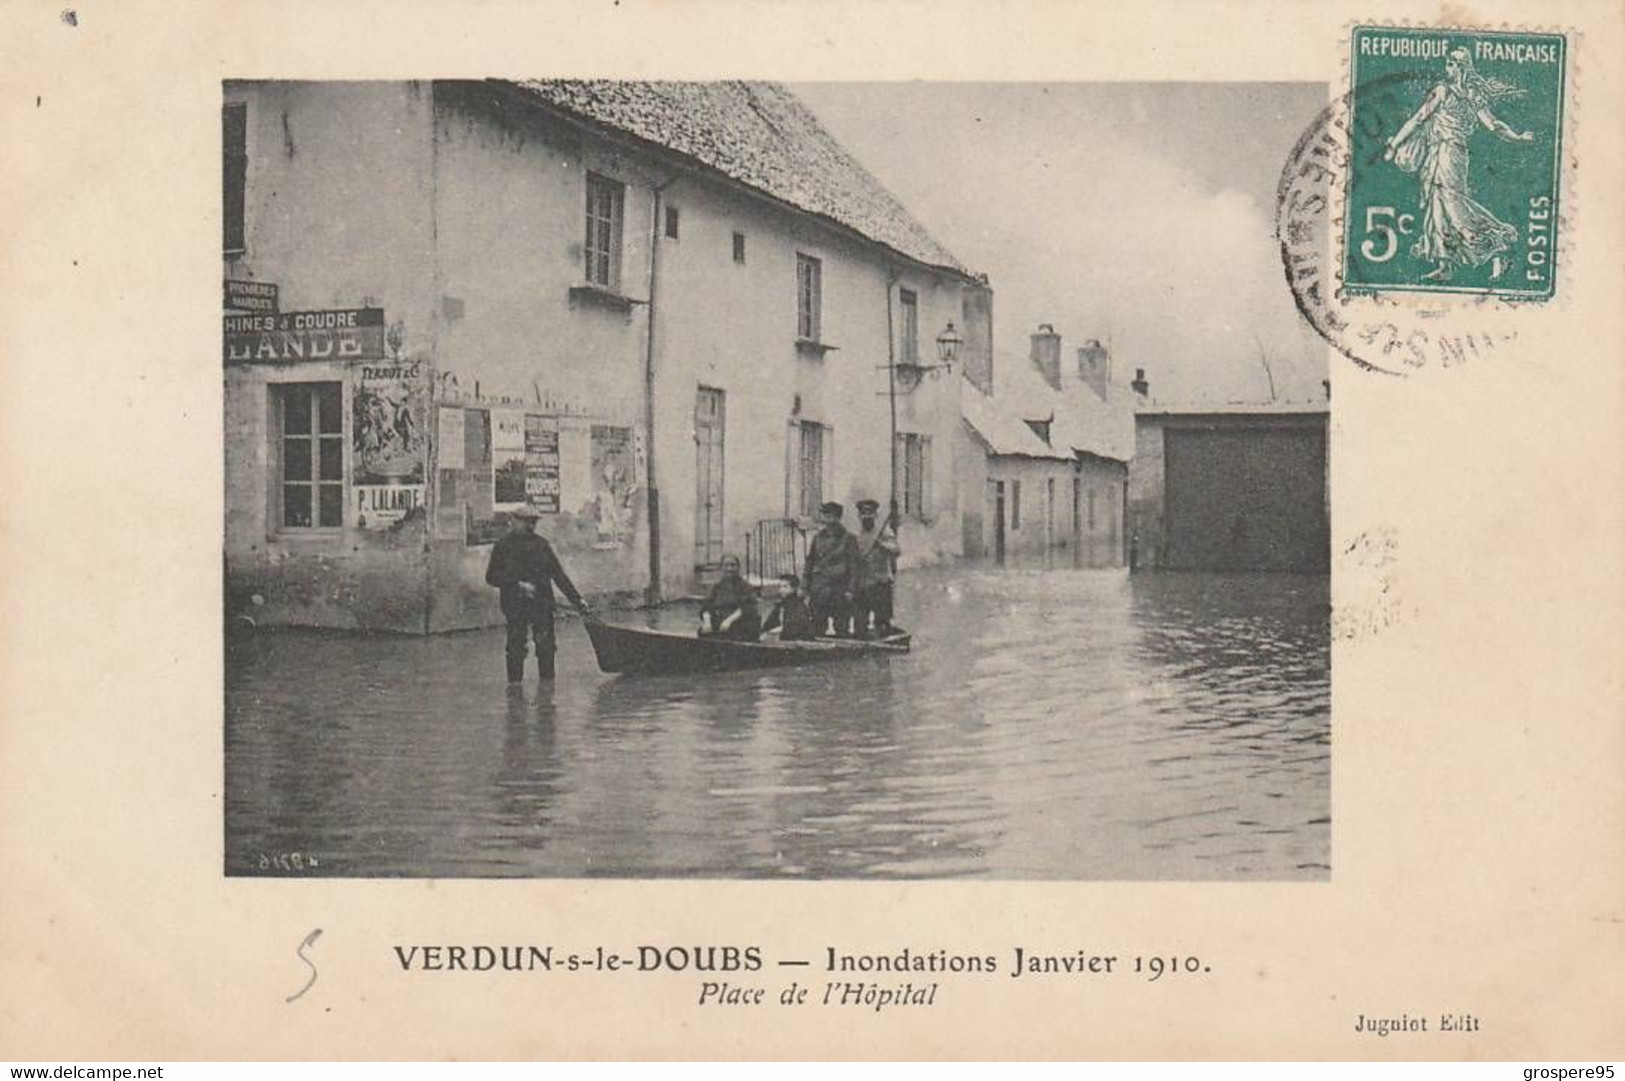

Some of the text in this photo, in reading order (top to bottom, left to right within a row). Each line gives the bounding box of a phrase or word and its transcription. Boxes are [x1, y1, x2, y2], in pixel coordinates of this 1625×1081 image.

[1475, 41, 1557, 64] FRANÇAISE
[1527, 195, 1549, 281] POSTES
[295, 312, 357, 328] COUDRE
[230, 331, 362, 360] LANDE
[372, 488, 418, 511] LALANDE
[393, 945, 1213, 982] VERDUN-s-le-DOUBS Inondations Janvier 1910.
[699, 981, 938, 1012] Place de l'Hôpital
